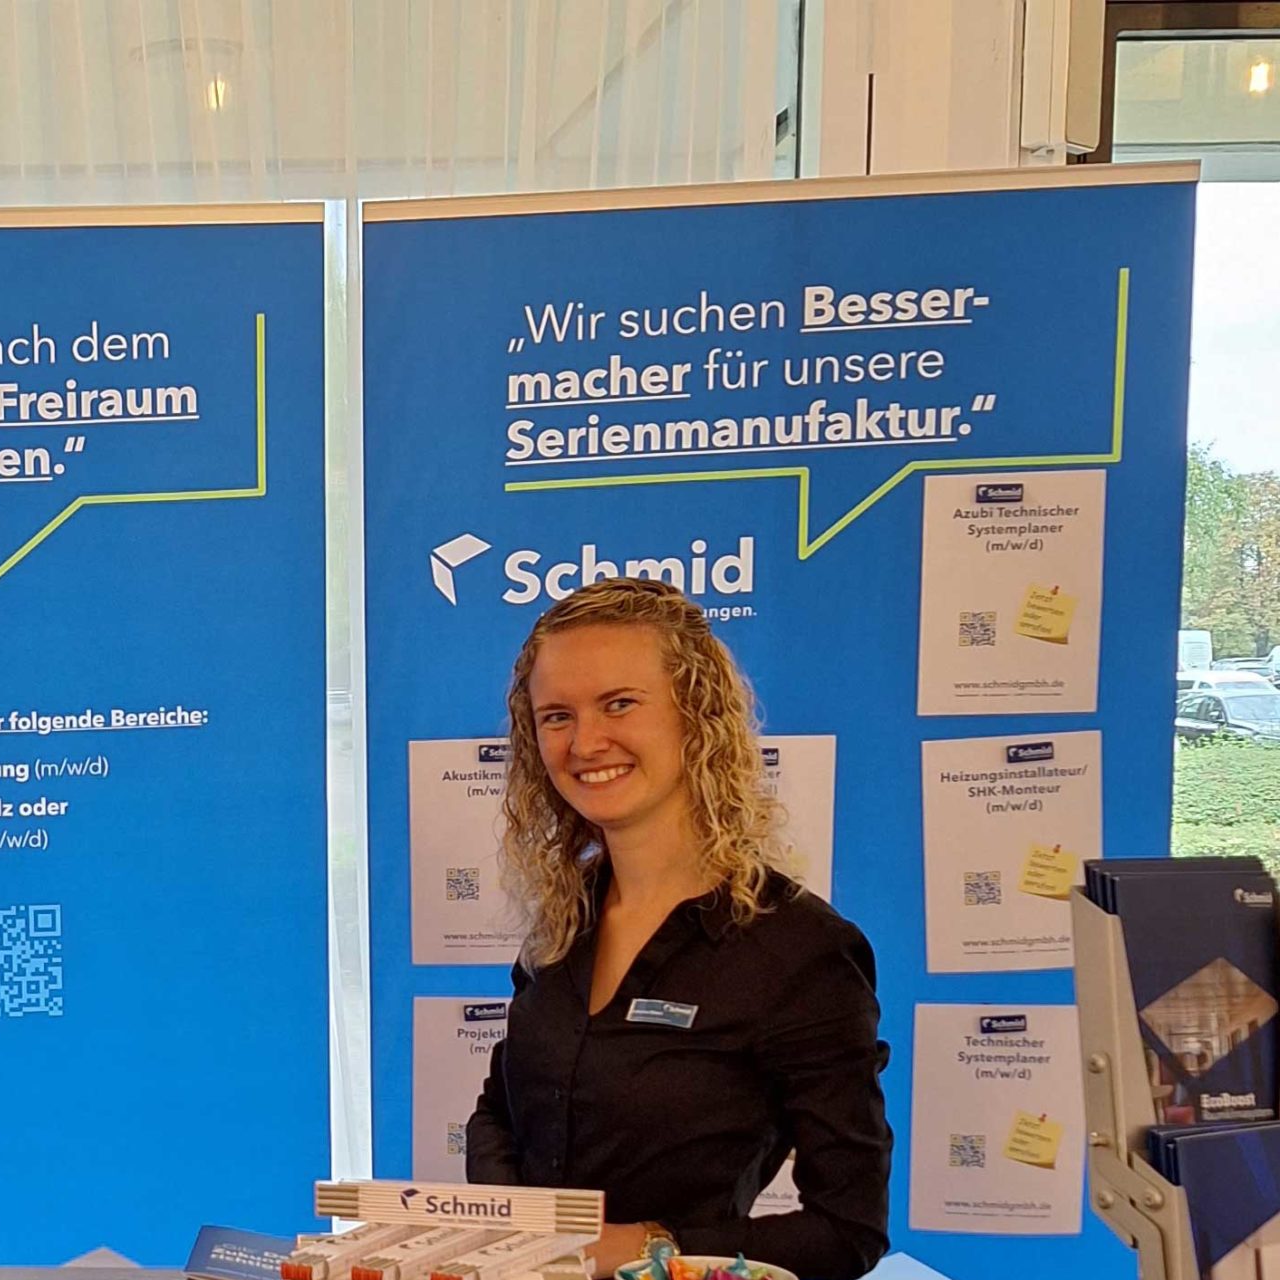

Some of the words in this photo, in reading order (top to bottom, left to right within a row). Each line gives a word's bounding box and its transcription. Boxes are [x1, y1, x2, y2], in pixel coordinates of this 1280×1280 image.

[507, 301, 605, 353] „Wir
[619, 291, 786, 338] suchen
[801, 285, 990, 328] Besser-
[72, 320, 170, 363] dem
[507, 354, 691, 404] macher
[703, 348, 769, 391] für
[783, 349, 944, 386] unsere
[506, 394, 996, 460] Serienmanufaktur.“
[953, 507, 993, 519] Azubi
[997, 505, 1079, 518] Technischer
[967, 523, 1064, 538] Systemplaner
[986, 540, 1043, 552] (m/w/d)
[502, 536, 754, 604] Schmid
[9, 710, 105, 735] folgende
[111, 706, 208, 728] Bereiche:
[34, 756, 109, 781] (m/w/d)
[442, 770, 503, 781] Akustikm
[940, 765, 1088, 783] Heizungsinstallateur/
[968, 785, 1061, 798] SHK-Monteur
[19, 797, 69, 816] oder
[986, 800, 1043, 814] (m/w/d)
[964, 1036, 1045, 1049] Technischer
[957, 1052, 1052, 1066] Systemplaner
[975, 1069, 1032, 1081] (m/w/d)
[425, 1195, 511, 1217] Schmid
